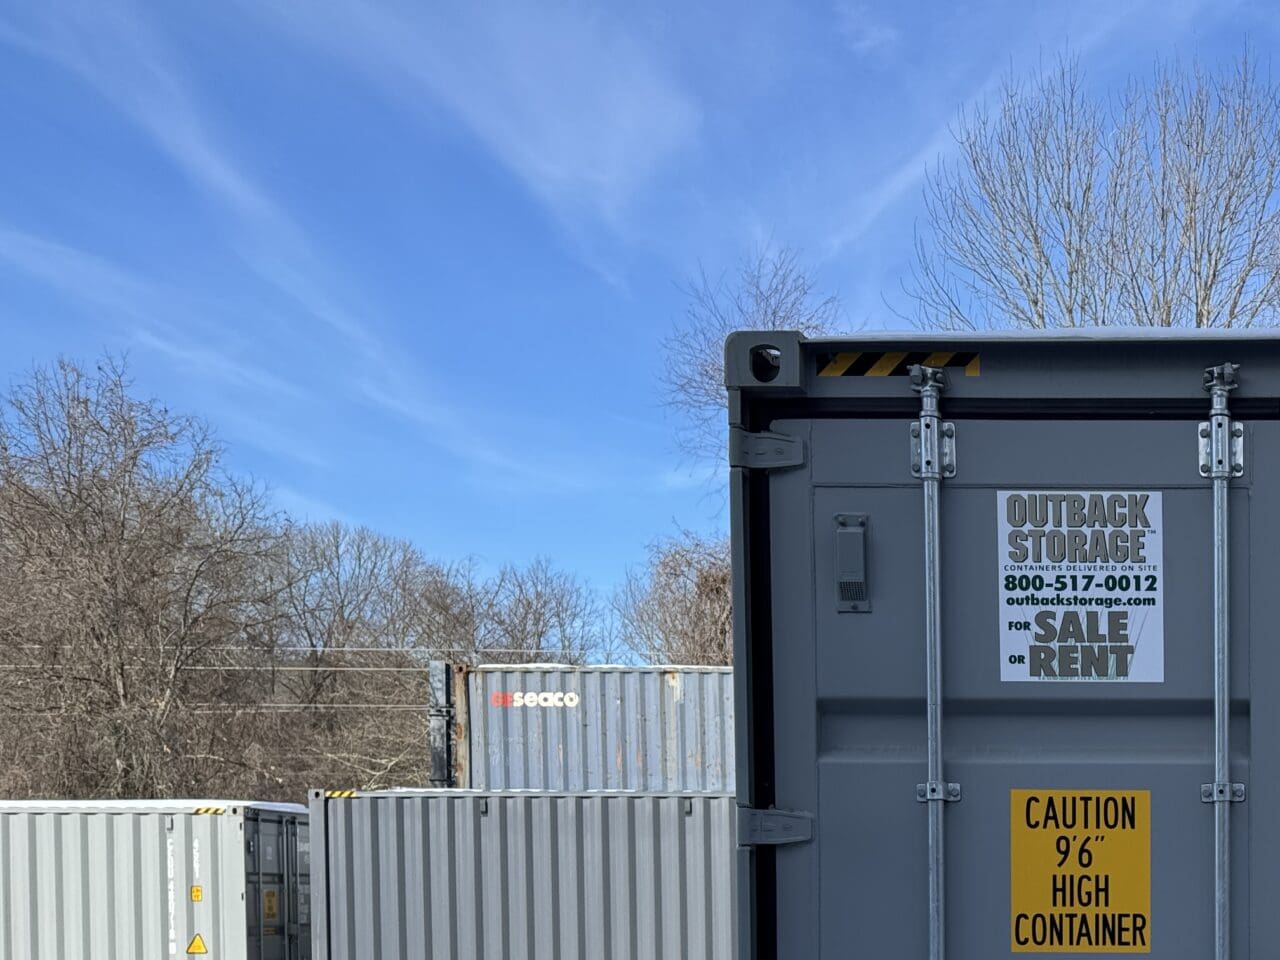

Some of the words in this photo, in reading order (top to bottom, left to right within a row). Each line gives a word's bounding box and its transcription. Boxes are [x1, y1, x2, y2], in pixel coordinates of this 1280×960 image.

[1006, 494, 1151, 528] OUTBACK
[1008, 529, 1146, 563] STORAGE
[1004, 575, 1157, 591] 800-517-0012
[1006, 594, 1156, 608] outbackstorage.com
[1008, 621, 1031, 631] FOR
[1034, 610, 1129, 644] SALE
[1008, 655, 1025, 664] OR
[1029, 645, 1135, 677] RENT
[1025, 796, 1136, 829] CAUTION
[1052, 874, 1110, 907] HIGH
[1014, 913, 1147, 946] CONTAINER
